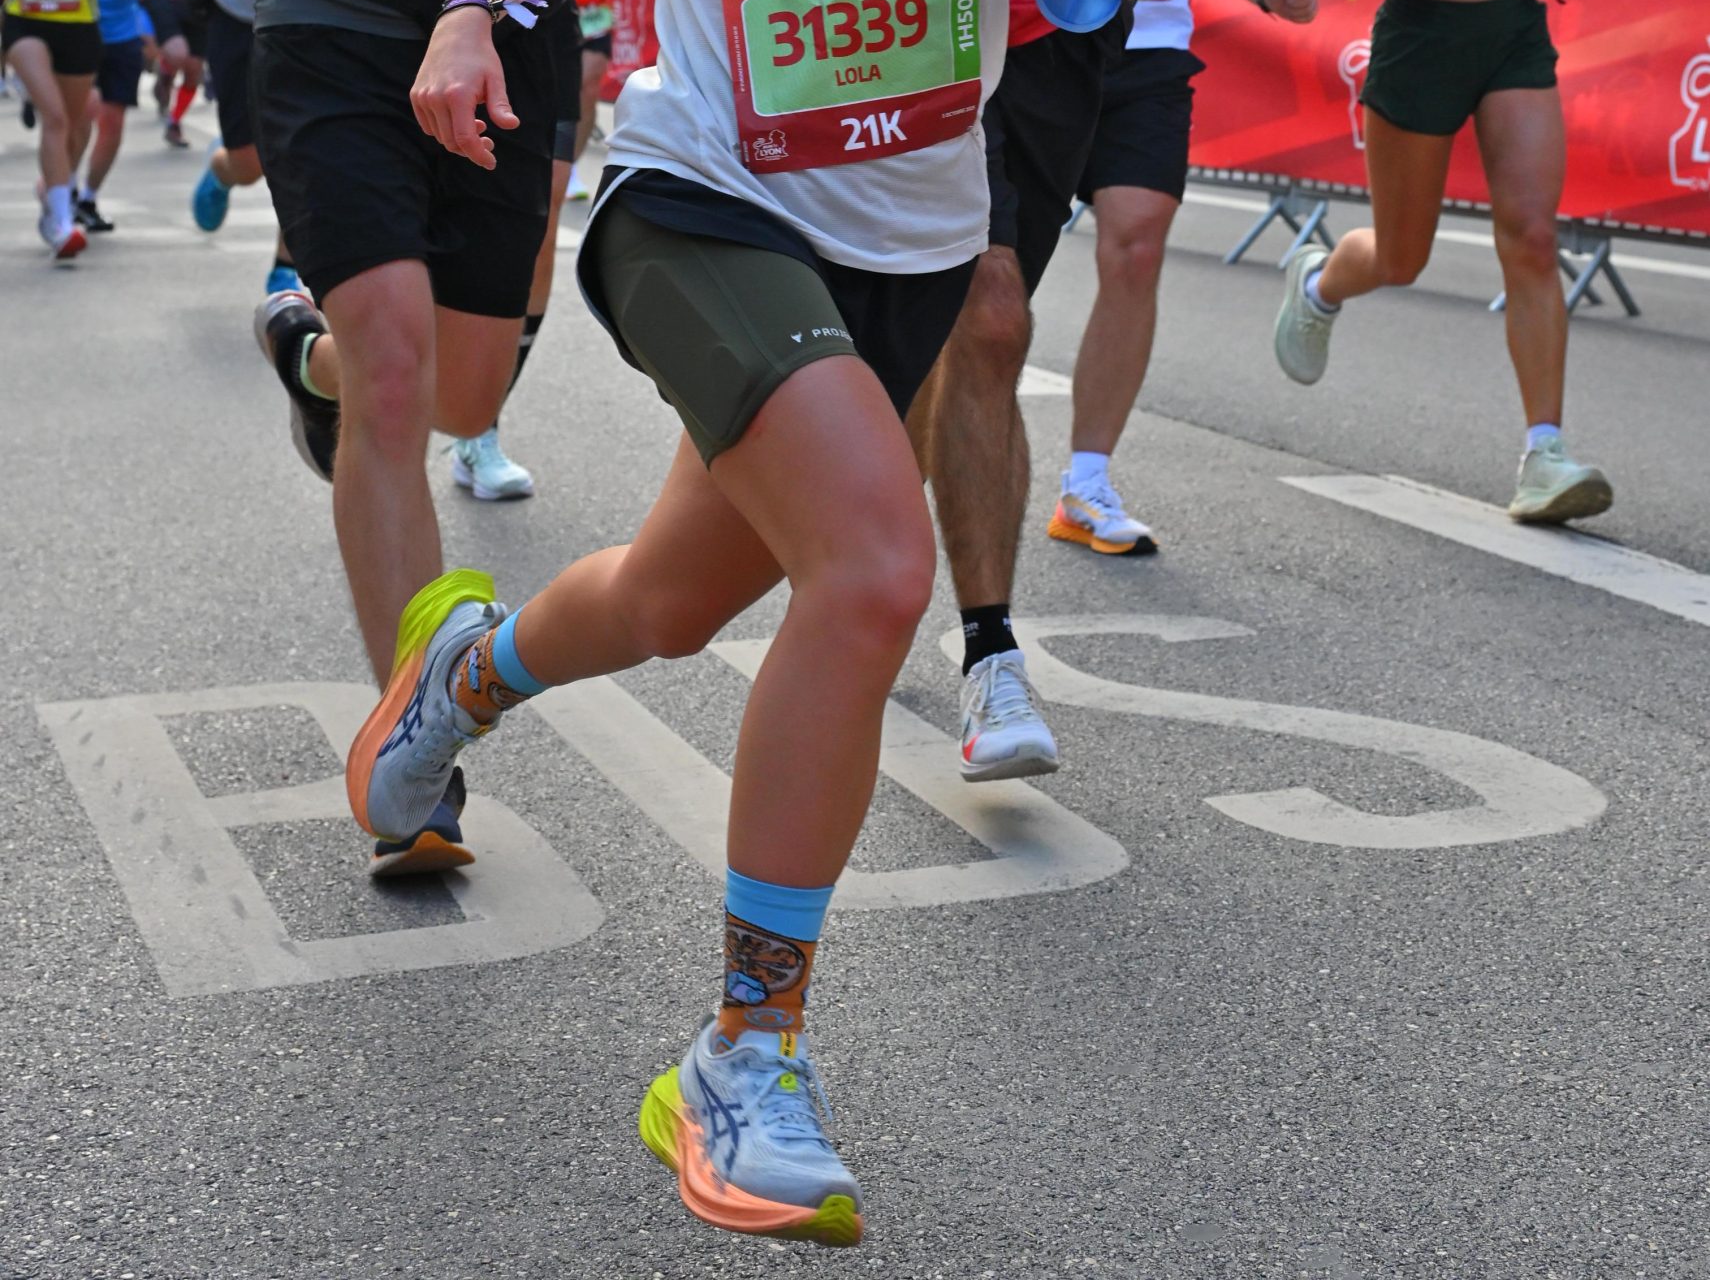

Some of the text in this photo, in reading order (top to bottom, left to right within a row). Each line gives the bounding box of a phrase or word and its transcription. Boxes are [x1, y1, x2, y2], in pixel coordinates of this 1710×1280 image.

[834, 64, 882, 87] LOLA
[840, 109, 908, 151] 21K
[37, 612, 1609, 998] BUS
